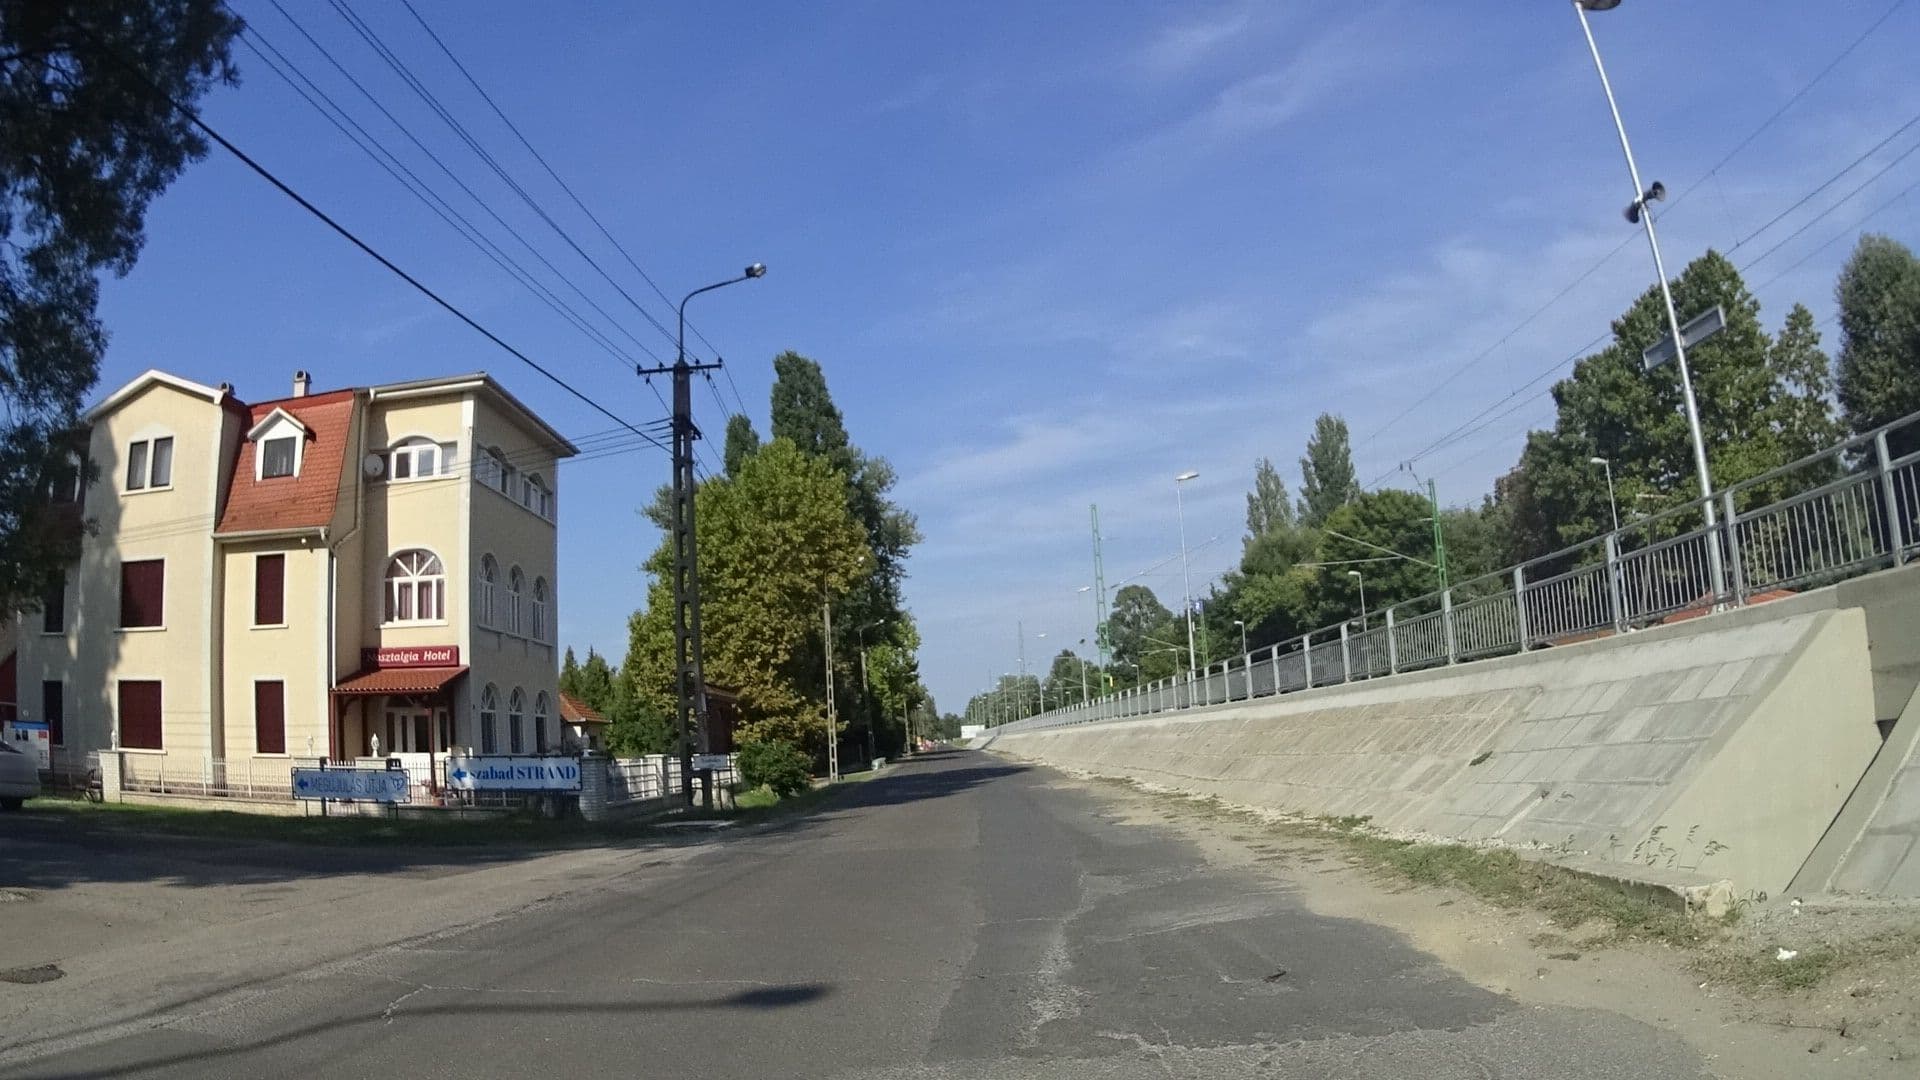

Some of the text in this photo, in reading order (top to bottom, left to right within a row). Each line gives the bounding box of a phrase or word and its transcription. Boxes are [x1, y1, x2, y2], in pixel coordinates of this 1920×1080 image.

[423, 650, 451, 661] Hotel
[470, 766, 577, 780] szabad STRAND
